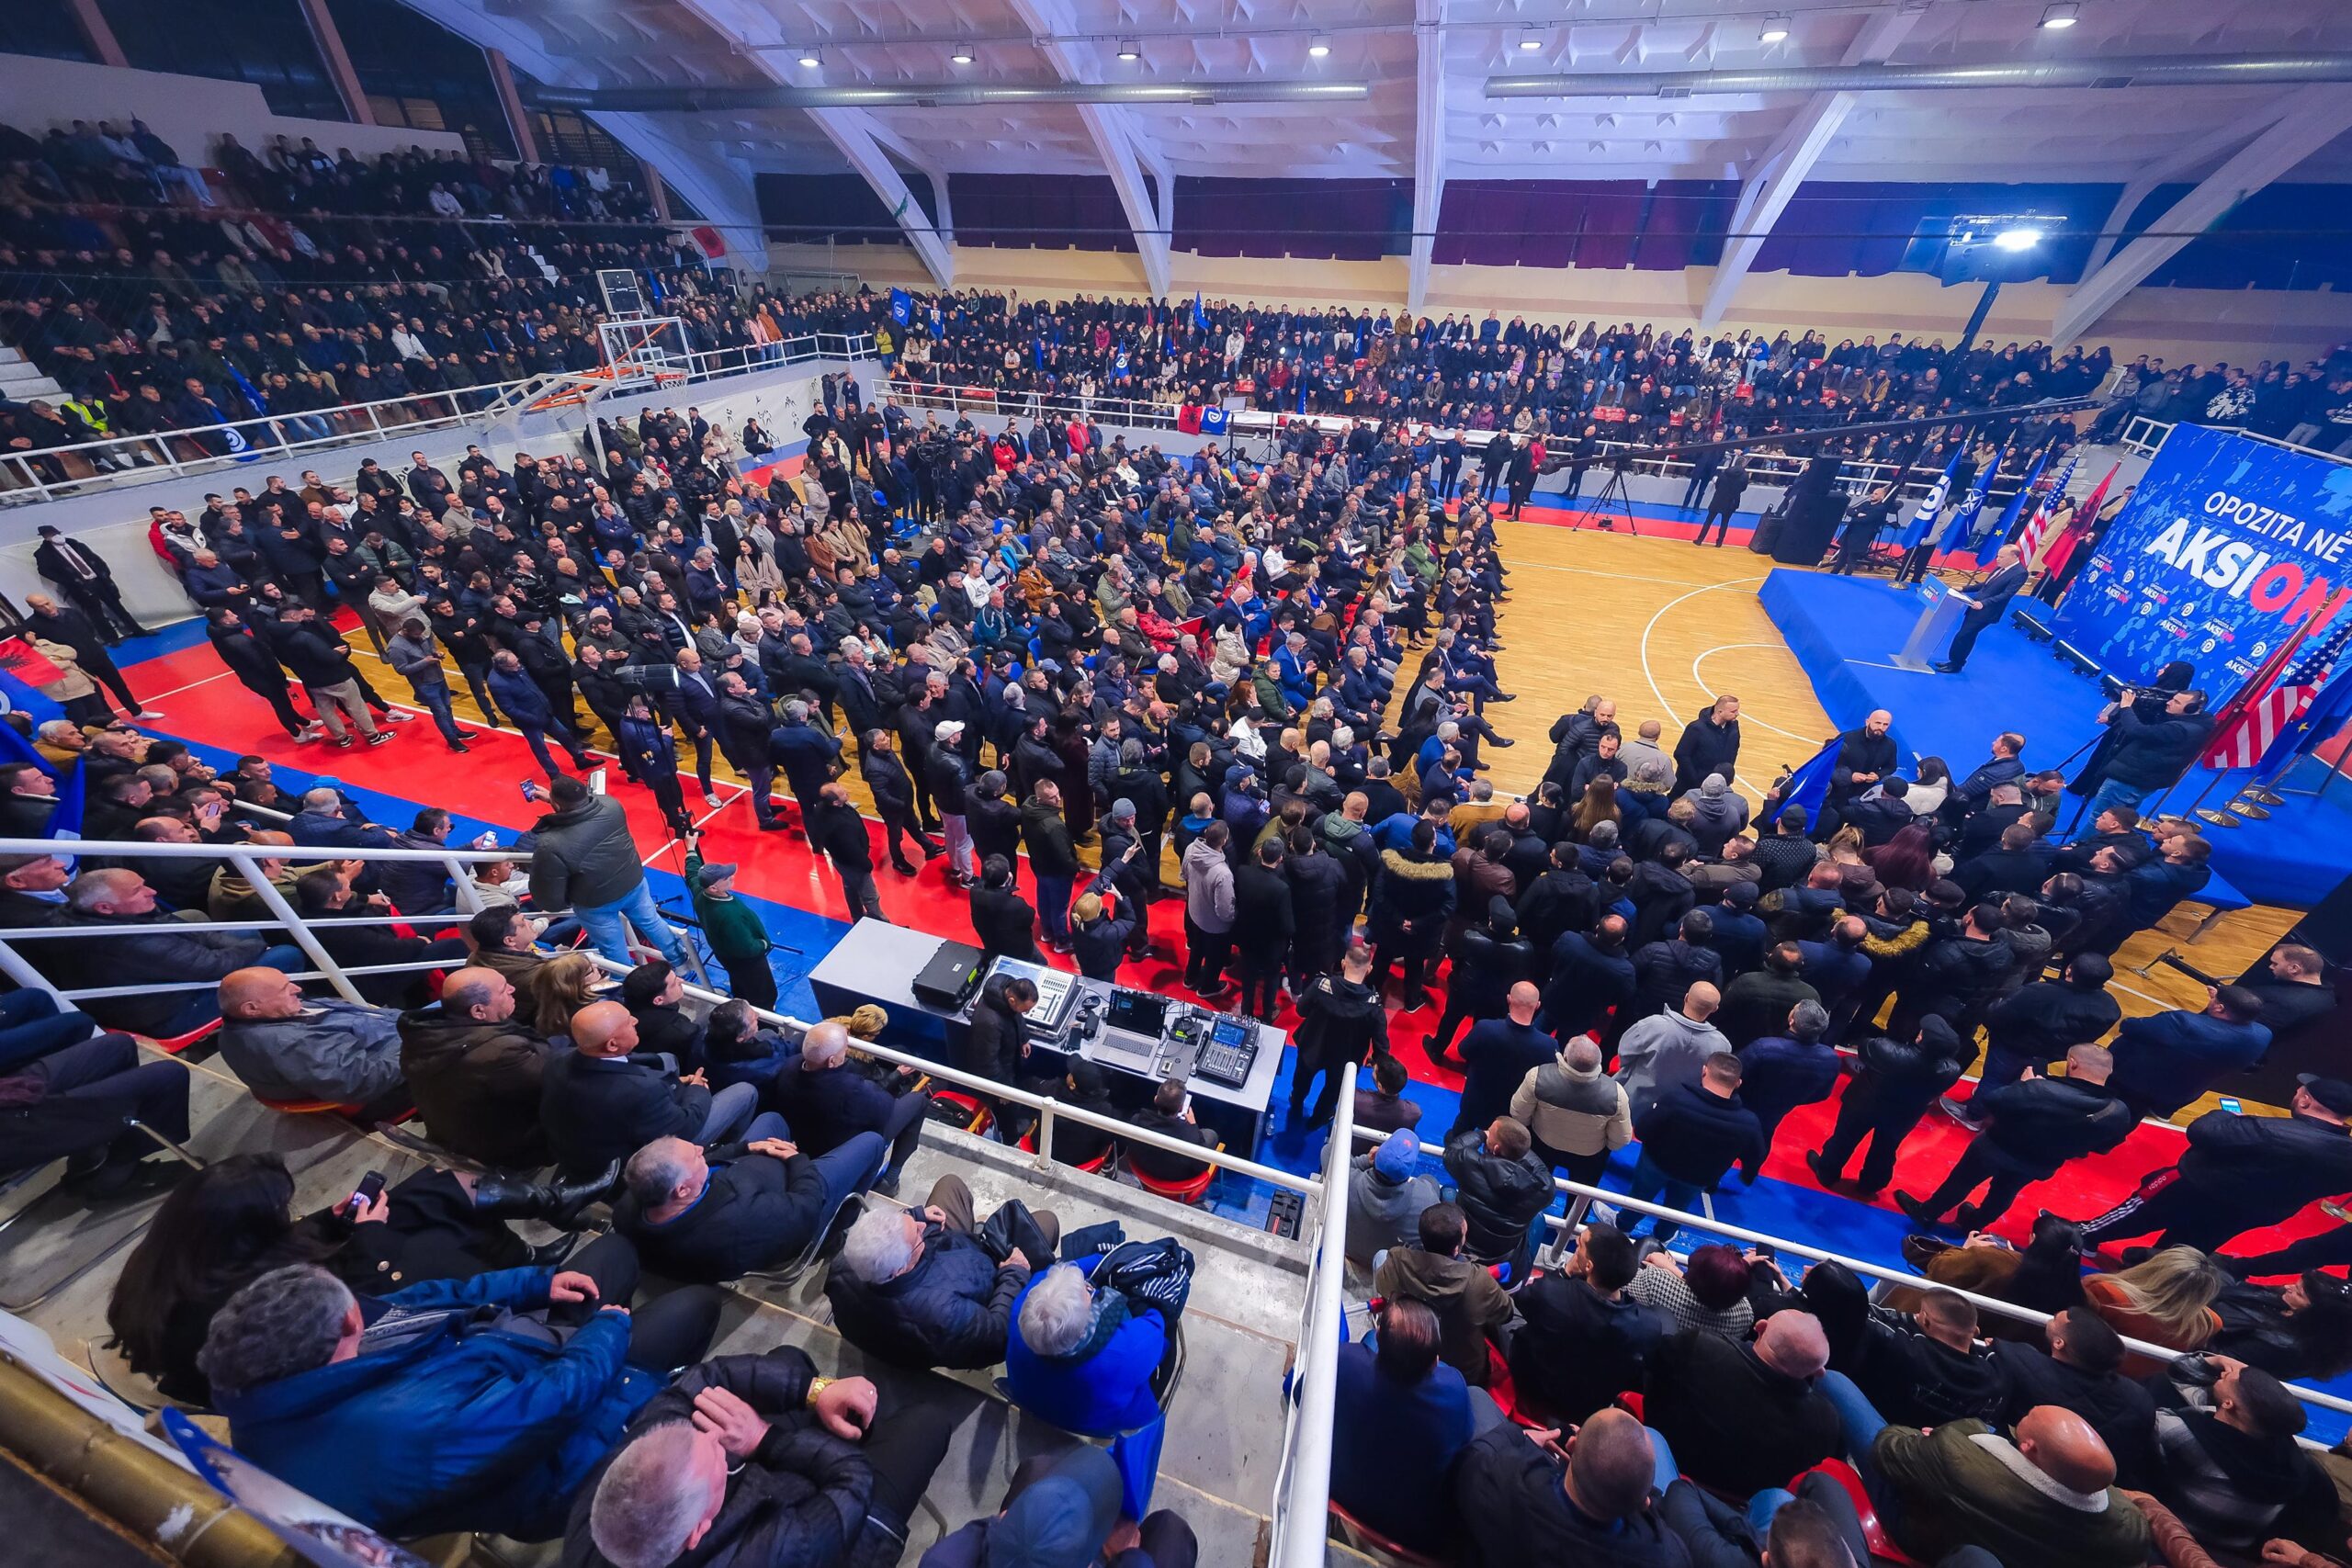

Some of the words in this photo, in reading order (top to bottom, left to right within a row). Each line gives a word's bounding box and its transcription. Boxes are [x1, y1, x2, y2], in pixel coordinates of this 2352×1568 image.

[2204, 491, 2306, 547] OPOZITA
[2303, 528, 2352, 564] NË
[2143, 517, 2352, 637] AKSION
